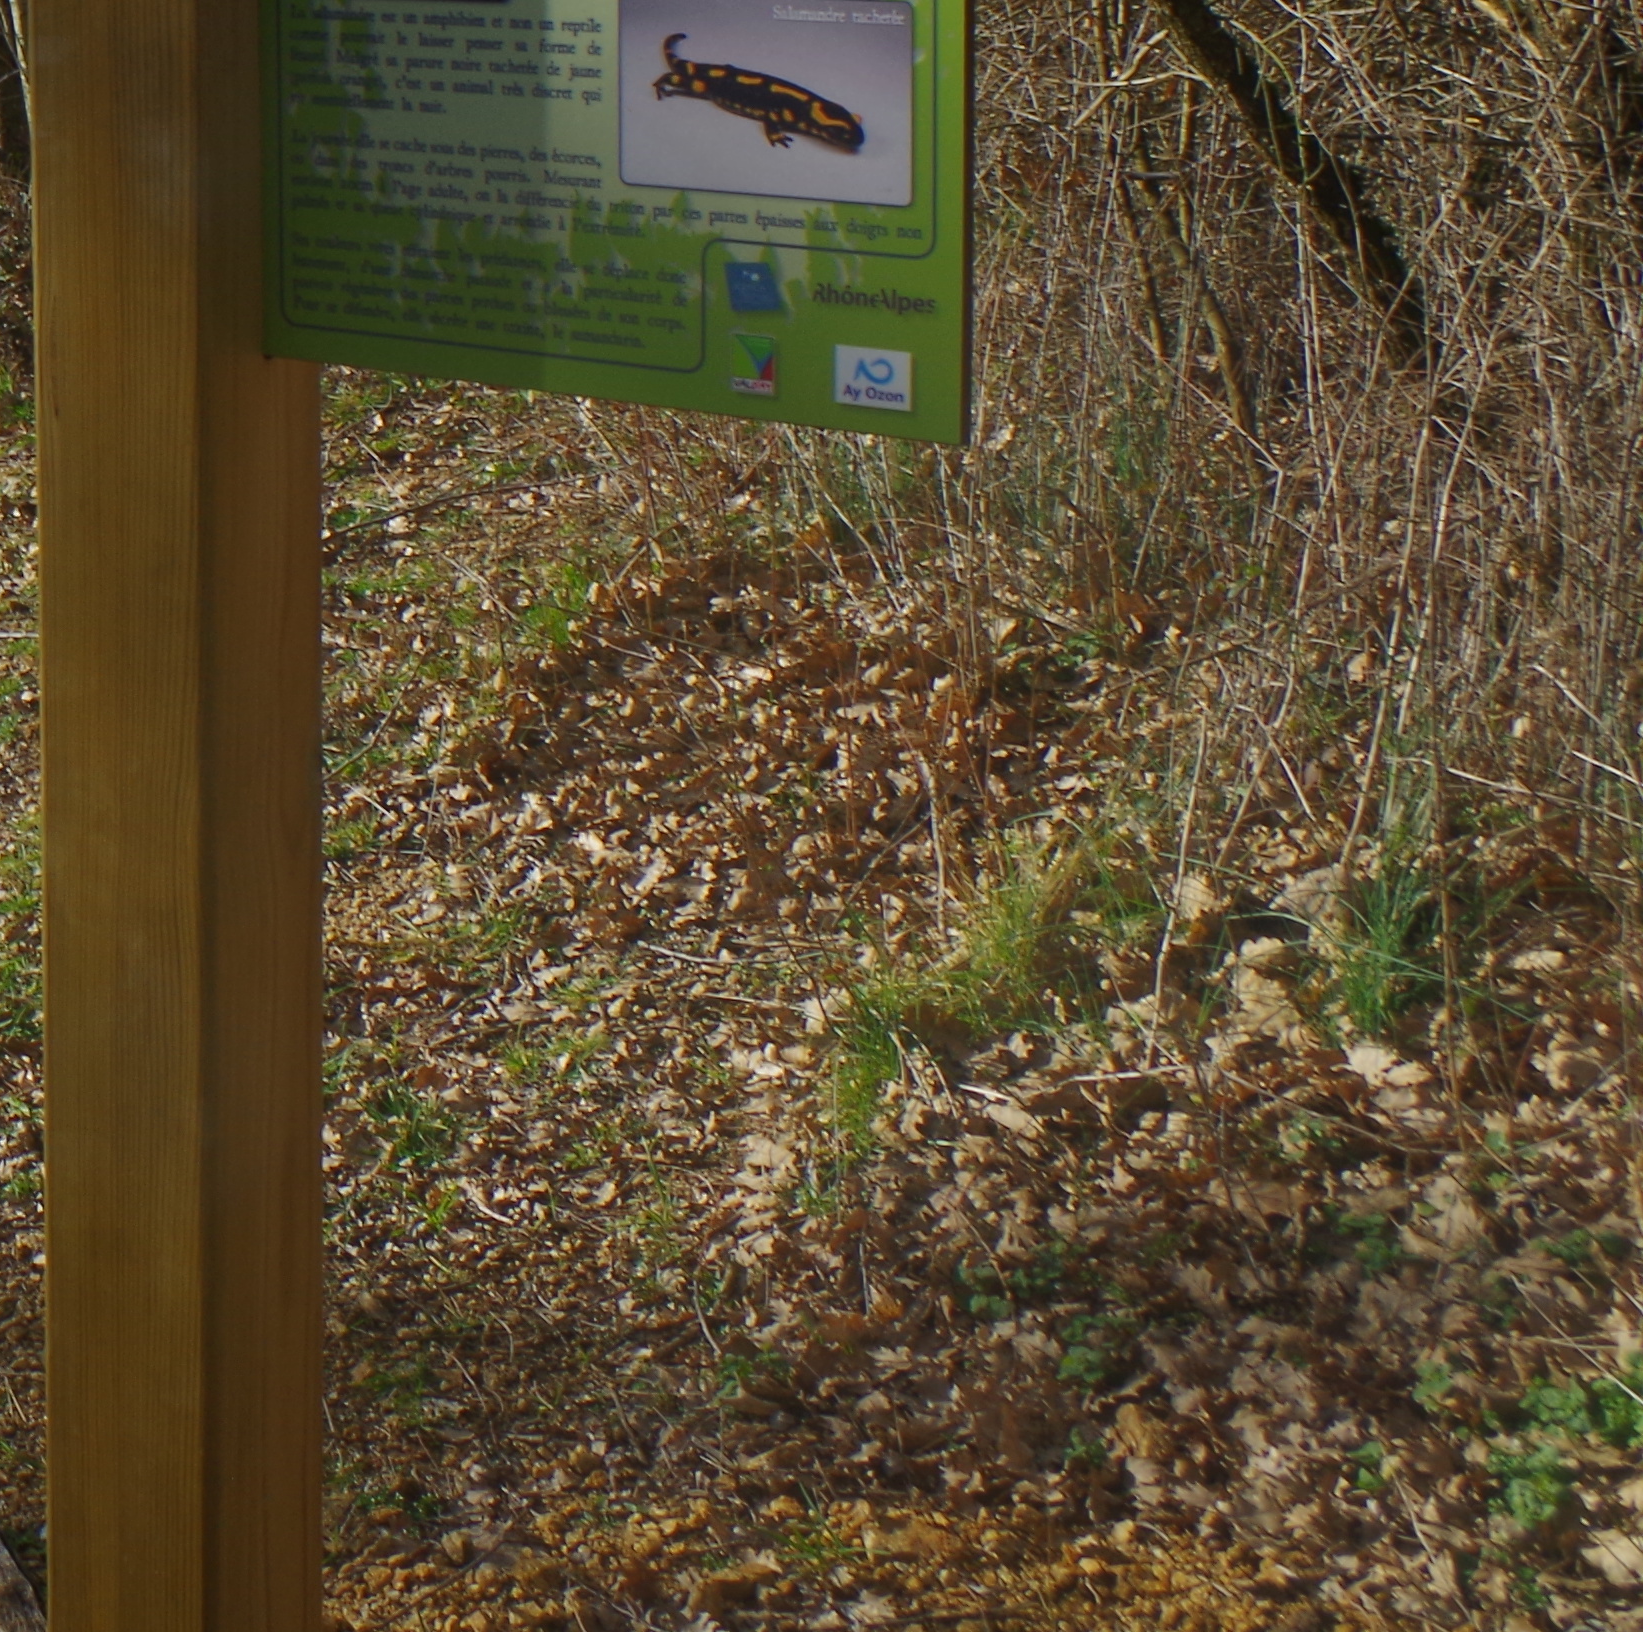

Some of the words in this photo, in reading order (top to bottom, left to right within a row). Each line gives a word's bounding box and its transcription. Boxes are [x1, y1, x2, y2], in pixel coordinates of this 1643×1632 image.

[772, 5, 845, 22] Salamandre
[586, 40, 601, 56] de
[546, 60, 560, 76] de
[581, 87, 601, 105] qui
[843, 384, 861, 401] Ay
[865, 387, 904, 403] Ozon
